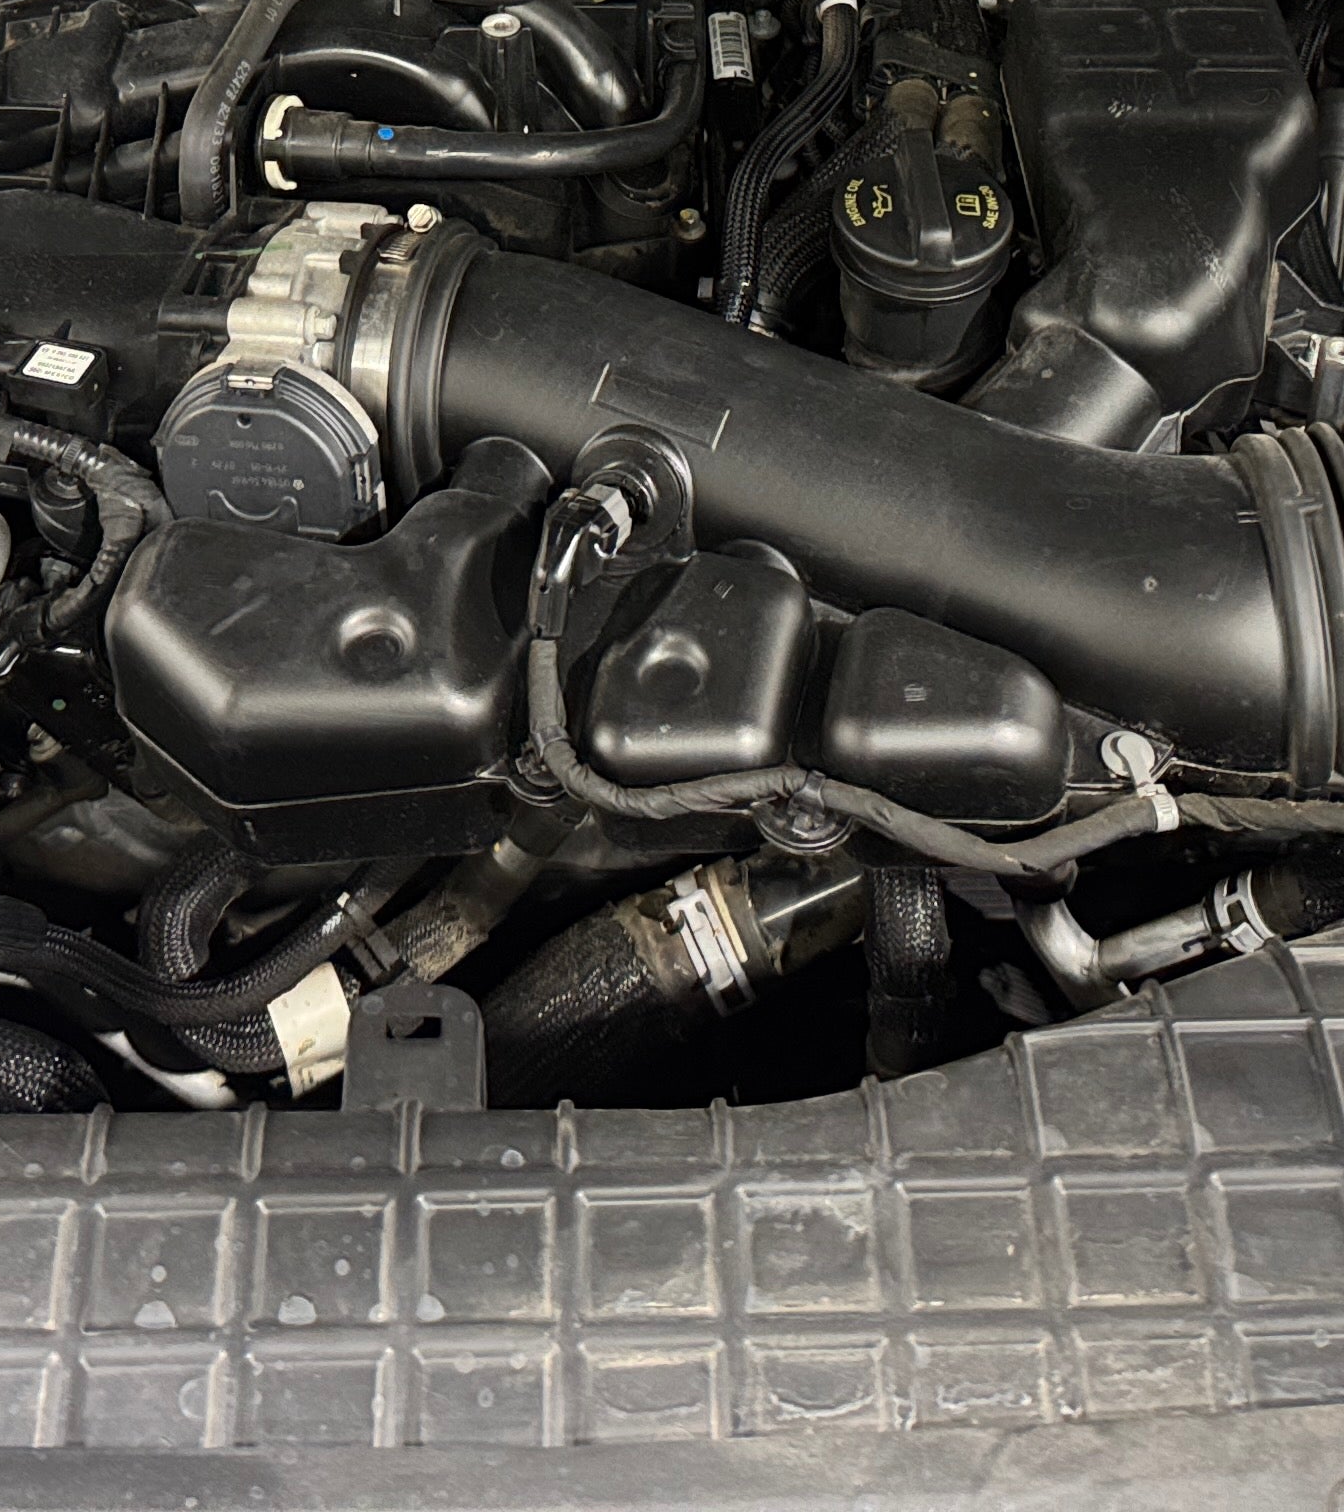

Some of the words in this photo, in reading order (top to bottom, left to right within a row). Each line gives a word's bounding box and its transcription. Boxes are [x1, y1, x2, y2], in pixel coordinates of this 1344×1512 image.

[846, 177, 865, 192] OIL
[844, 192, 867, 227] ENGINE
[982, 209, 1000, 230] SAE
